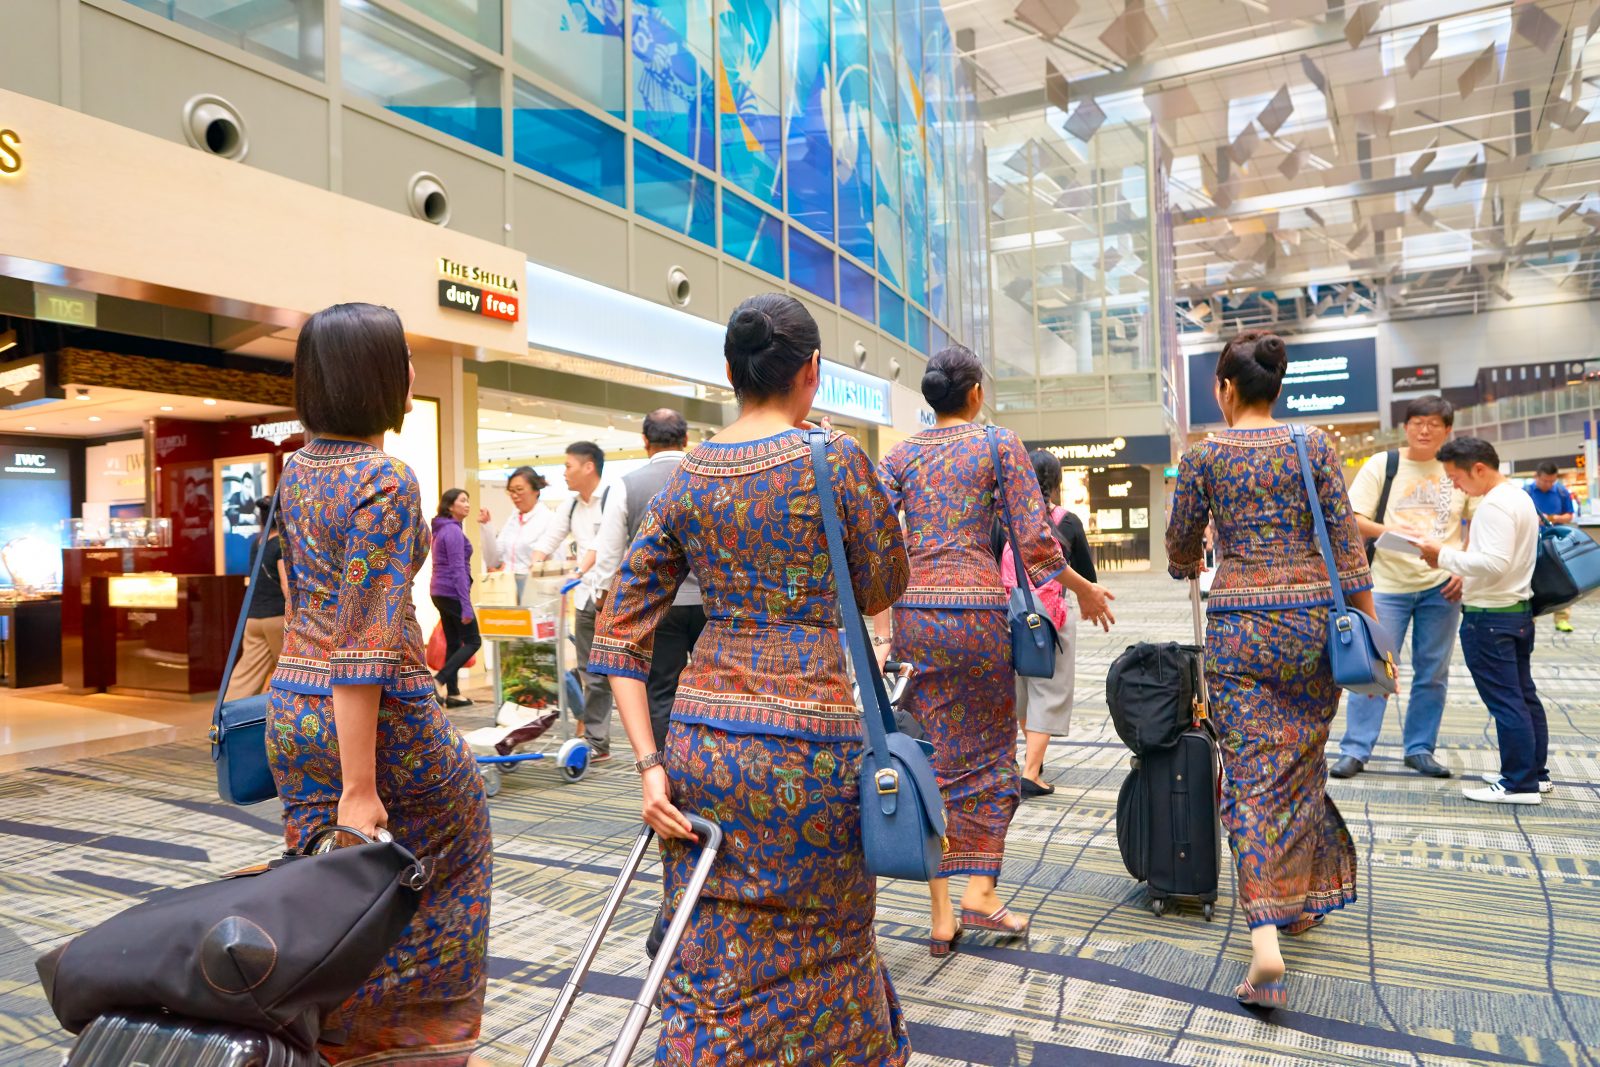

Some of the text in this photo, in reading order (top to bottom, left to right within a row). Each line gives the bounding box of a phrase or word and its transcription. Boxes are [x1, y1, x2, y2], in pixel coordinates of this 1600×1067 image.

[440, 257, 518, 291] THE SHILLA
[446, 285, 515, 316] duty free
[15, 453, 46, 467] IWC
[1038, 443, 1116, 459] ONTBLANC
